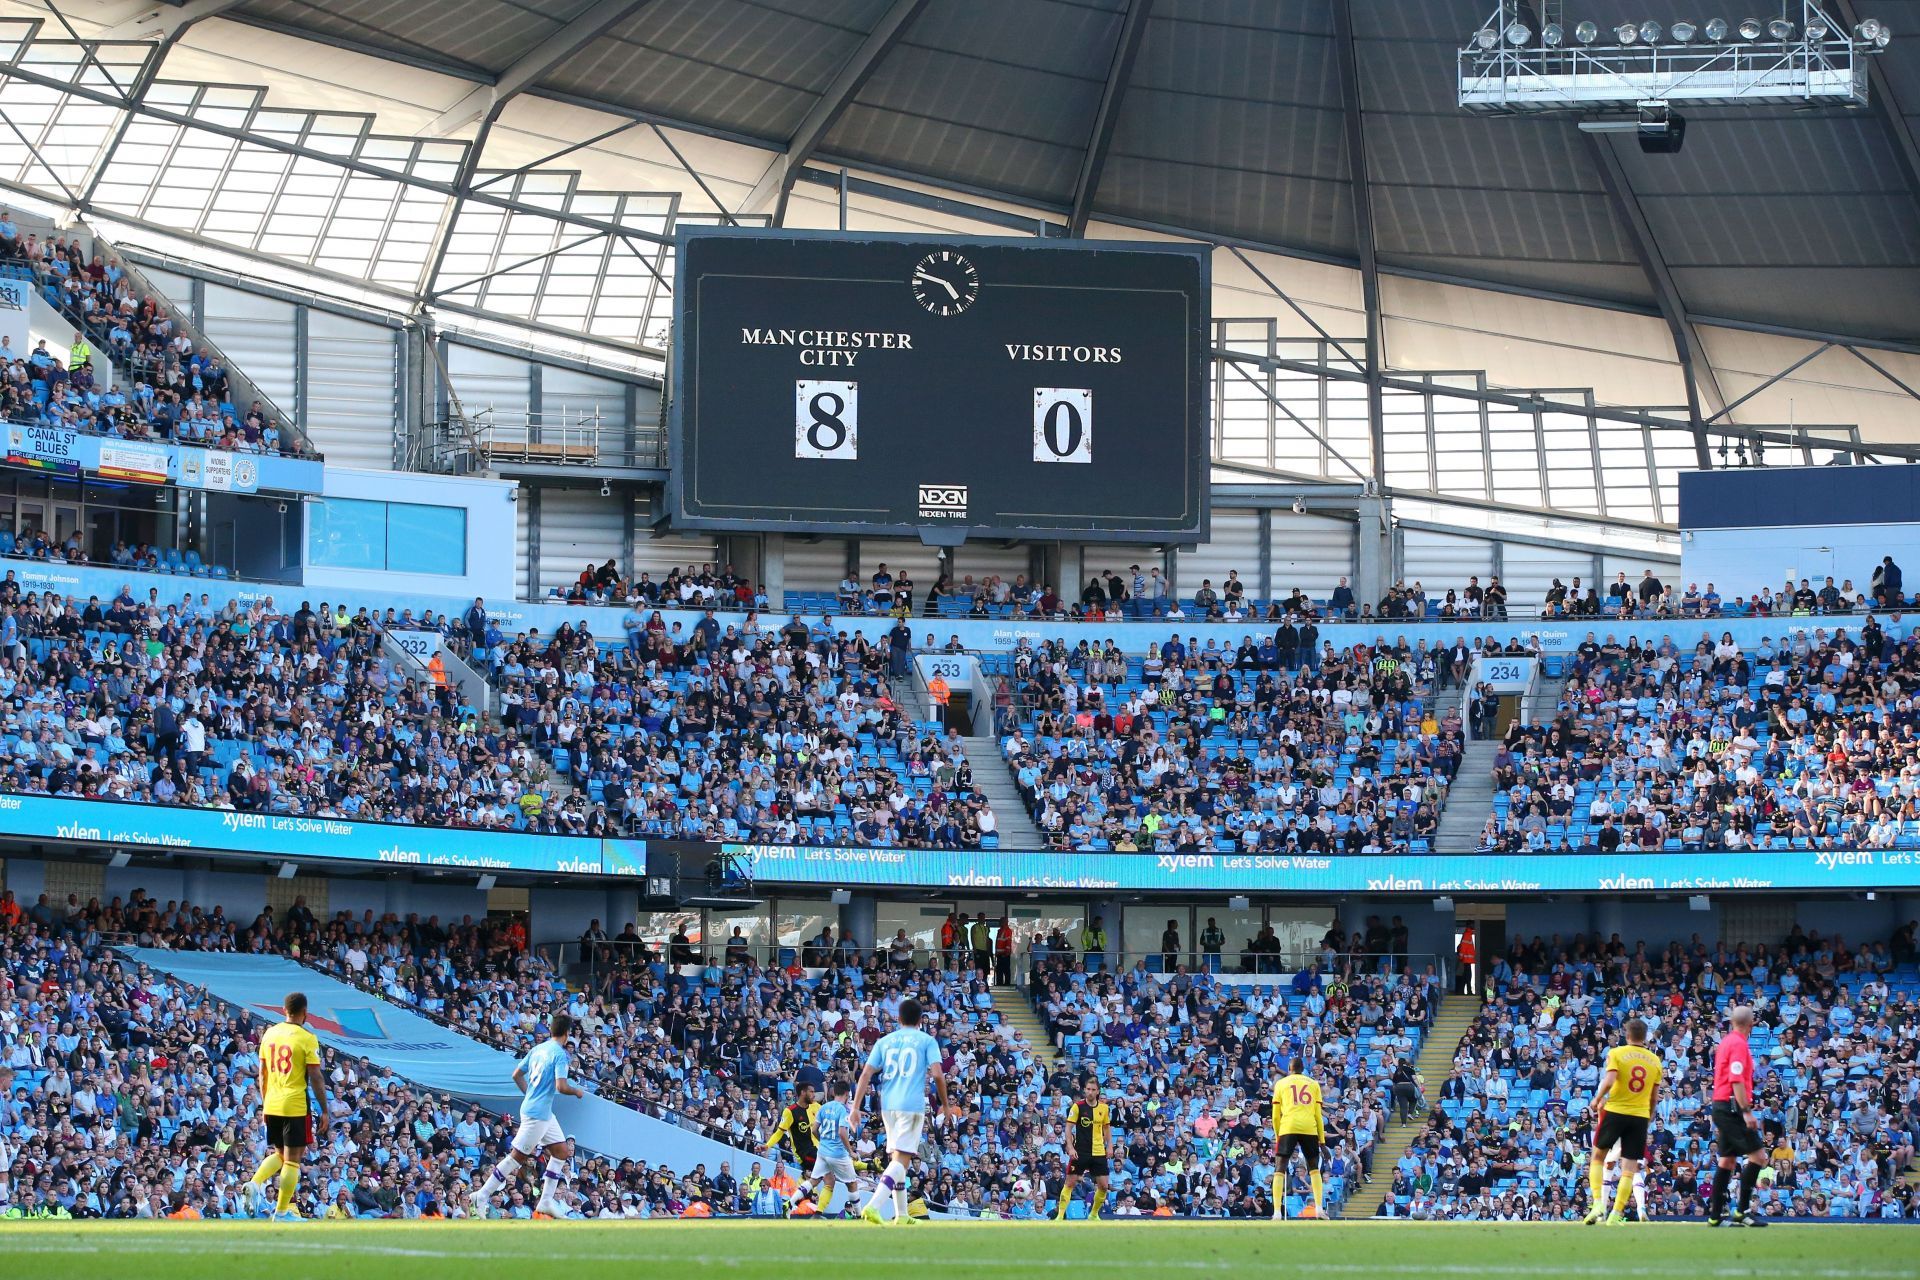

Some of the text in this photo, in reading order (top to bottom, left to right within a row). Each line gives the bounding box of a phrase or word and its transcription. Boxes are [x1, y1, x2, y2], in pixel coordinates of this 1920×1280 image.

[0, 287, 18, 302] 31
[741, 328, 913, 350] MANCHESTER
[799, 349, 858, 367] CITY
[1005, 344, 1122, 363] VISITORS
[807, 392, 846, 451] 8
[1044, 401, 1082, 457] 0
[28, 428, 77, 445] CANAL ST
[36, 441, 68, 456] BLUES
[919, 510, 967, 519] NEXEN TIRE
[22, 571, 48, 582] Tommy
[50, 573, 79, 584] Johnson
[239, 591, 254, 600] Paul
[994, 630, 1041, 638] Alan Oakes
[1542, 631, 1568, 639] Quinn
[401, 640, 428, 655] 232
[931, 663, 961, 678] 233
[1490, 666, 1520, 680] 234
[0, 795, 22, 810] ater
[223, 812, 353, 835] xylem Let's Solve Water
[56, 820, 192, 847] xylem Let's Solve Water
[378, 845, 511, 869] xylem Let's Solve Water
[743, 845, 906, 863] xylem Let's Solve Water
[1815, 852, 1874, 870] xylem
[1882, 852, 1912, 864] Let's
[1157, 855, 1331, 872] xylem Let's Solve Water
[1367, 874, 1540, 890] xylem Let's Solve Water
[1598, 873, 1772, 889] xylem Let's Solve Water
[269, 1043, 293, 1074] 18
[883, 1047, 918, 1080] 50
[1628, 1065, 1647, 1093] 8
[1290, 1084, 1313, 1106] 16
[820, 1118, 836, 1140] 21
